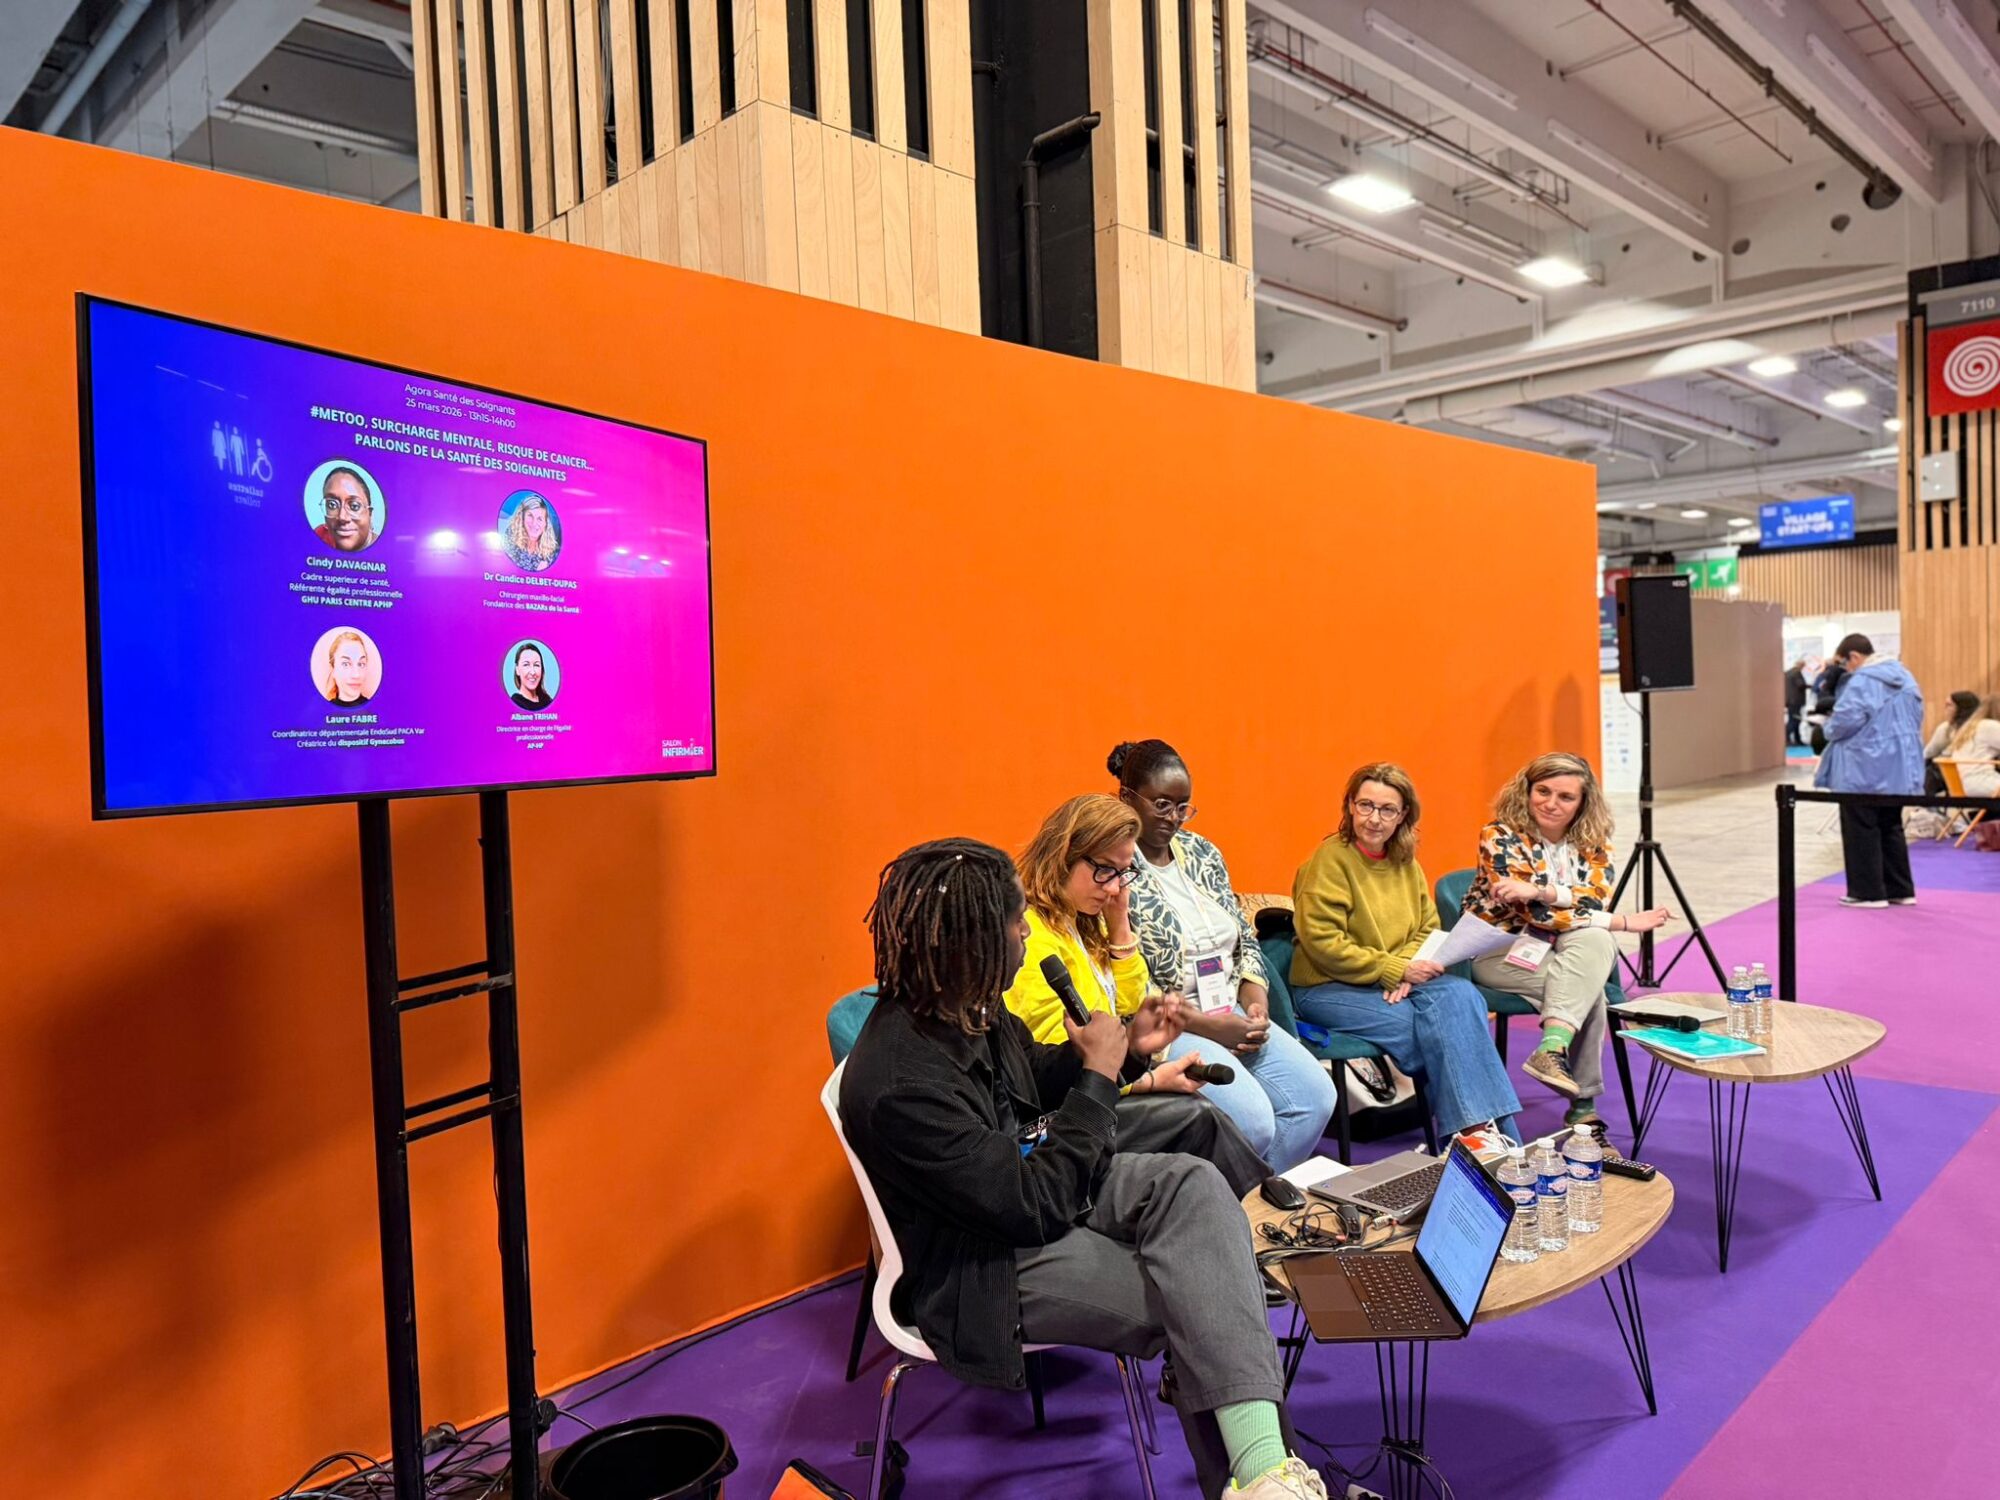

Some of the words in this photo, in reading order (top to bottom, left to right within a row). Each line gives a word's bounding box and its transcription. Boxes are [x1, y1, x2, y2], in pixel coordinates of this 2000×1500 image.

[1960, 297, 1996, 314] 7110
[405, 384, 431, 397] Agora
[434, 389, 457, 402] Santé
[460, 395, 474, 406] des
[476, 398, 516, 416] Soignants
[406, 397, 416, 408] 25
[418, 401, 440, 412] mars
[442, 405, 462, 417] 2026
[468, 410, 516, 428] 13h15-14h00
[310, 406, 368, 429] #METOO,
[372, 418, 440, 440] SURCHARGE
[443, 432, 494, 453] MENTALE,
[498, 442, 534, 460] RISQUE
[536, 450, 548, 462] DE
[550, 453, 594, 471] CANCER...
[356, 434, 410, 454] PARLONS
[414, 445, 428, 457] DE
[431, 448, 444, 460] LA
[447, 451, 481, 466] SANTÉ
[484, 456, 502, 470] DES
[505, 460, 566, 482] SOIGNANTES
[306, 556, 334, 570] Cindy
[336, 560, 386, 572] DAVAGNAR
[301, 572, 323, 582] Cadre
[484, 572, 494, 581] Dr
[496, 574, 524, 584] Candice
[526, 577, 578, 589] DELBET-DUPAS
[290, 583, 325, 593] Référente
[327, 586, 350, 596] égalité
[352, 588, 402, 598] professionnelle
[499, 591, 528, 601] Chirurgien
[302, 596, 319, 604] GHU
[321, 597, 342, 606] PARIS
[344, 598, 372, 607] CENTRE
[374, 600, 393, 608] APHP
[483, 600, 514, 609] Fondatrice
[564, 606, 580, 614] Santé
[326, 715, 350, 724] Laure
[352, 714, 378, 723] FABRE
[272, 730, 317, 738] Coordinatrice
[319, 729, 369, 738] départementale
[297, 739, 326, 748] Créatrice
[338, 738, 368, 748] dispositif
